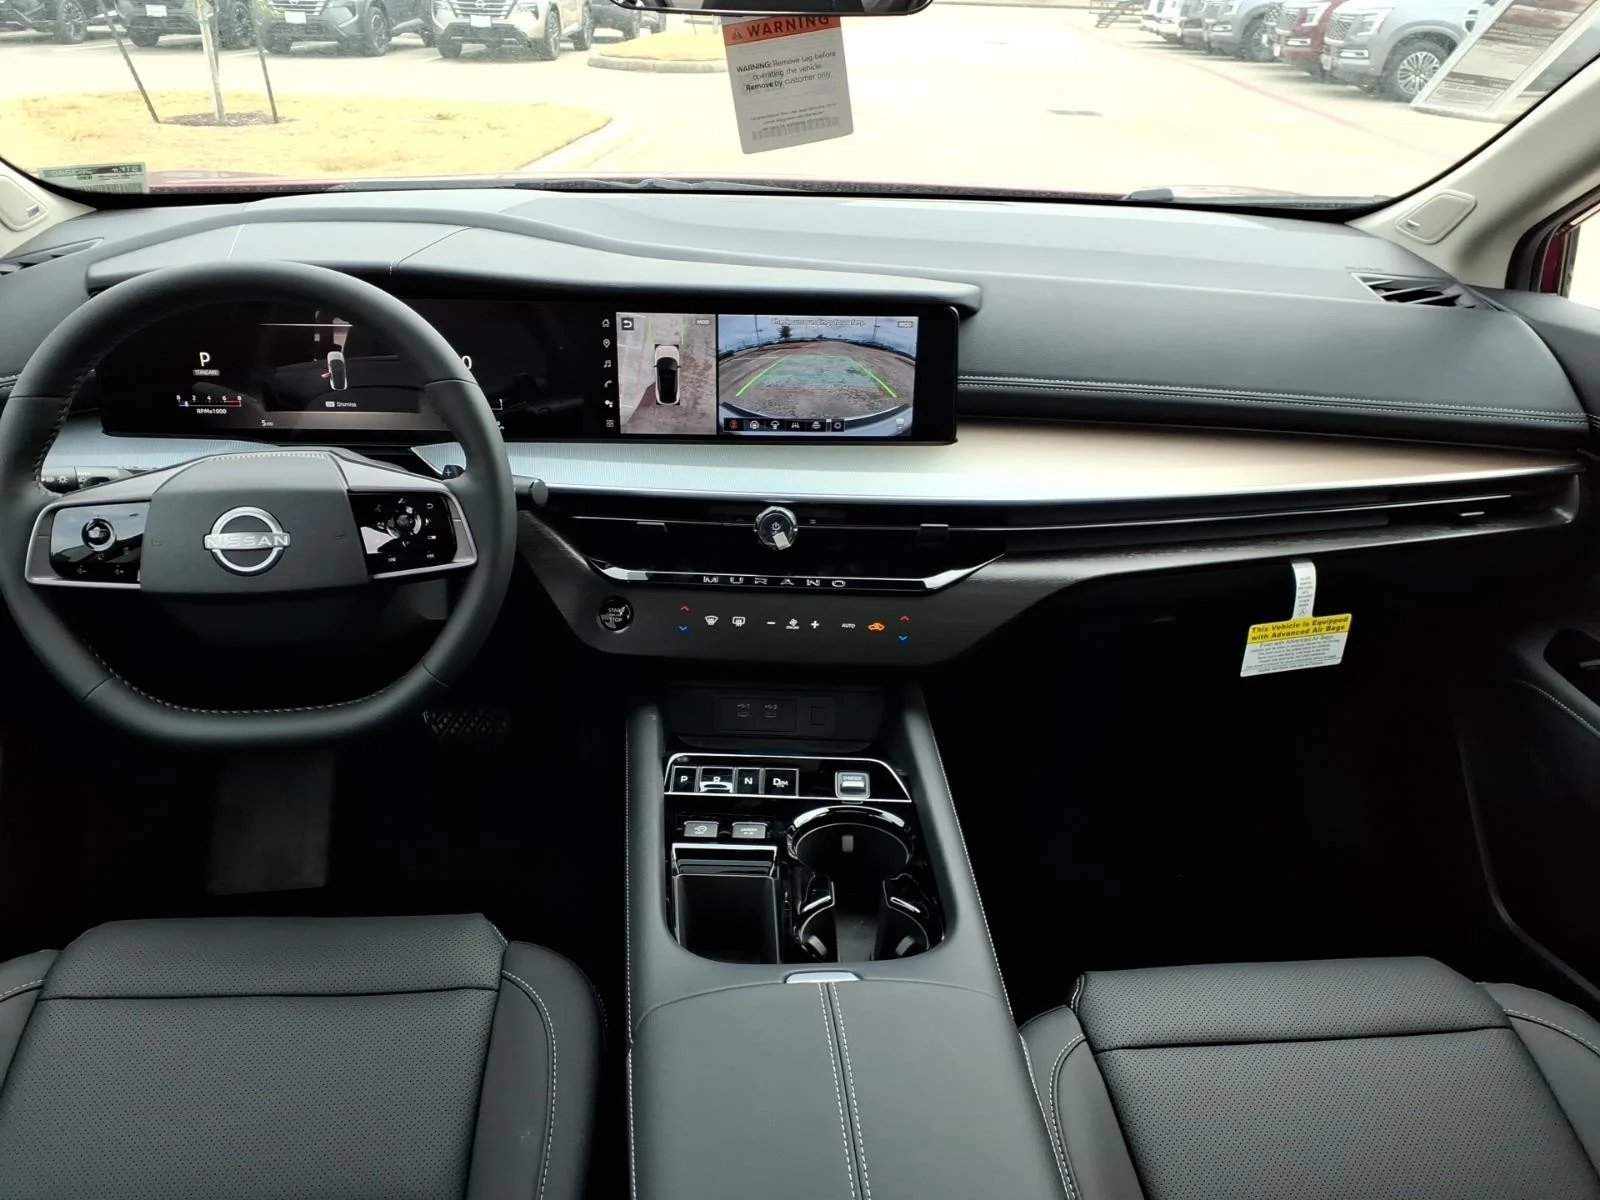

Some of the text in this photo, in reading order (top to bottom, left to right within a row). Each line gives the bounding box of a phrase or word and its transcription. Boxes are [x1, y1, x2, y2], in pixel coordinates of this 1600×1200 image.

[746, 16, 829, 37] WARNING
[736, 50, 836, 73] WARNING: Remove tag before
[752, 69, 784, 81] operating
[786, 66, 797, 75] the
[746, 81, 774, 91] Remove
[775, 79, 783, 88] by
[784, 74, 816, 85] customer
[199, 352, 211, 367] P
[207, 534, 289, 548] NISSAN
[702, 575, 846, 588] MURANO
[1271, 622, 1300, 631] Vehicle
[1312, 617, 1348, 626] Equipped
[1251, 633, 1269, 641] with
[1271, 629, 1310, 638] Advanced
[1325, 624, 1345, 632] Bags
[680, 775, 688, 783] P
[744, 777, 753, 785] N
